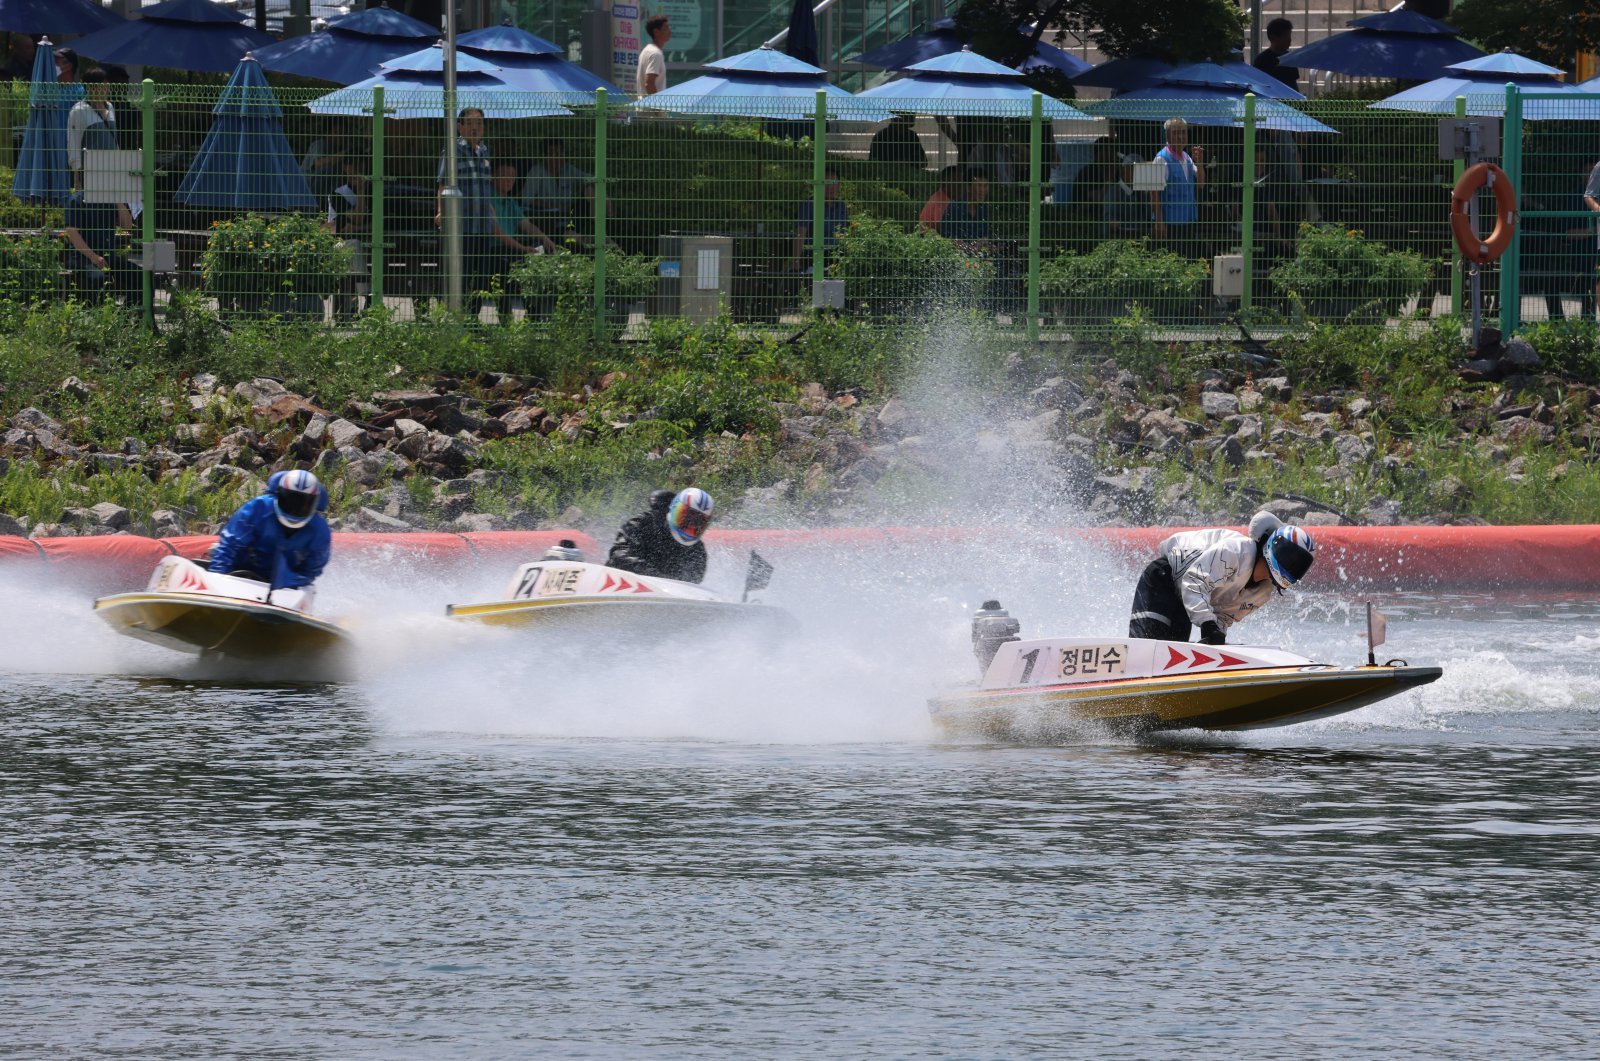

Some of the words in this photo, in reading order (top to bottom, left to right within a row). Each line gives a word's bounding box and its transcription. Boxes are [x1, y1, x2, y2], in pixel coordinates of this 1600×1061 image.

[613, 36, 639, 50] 아카데미
[516, 568, 540, 597] 2
[1020, 648, 1041, 683] 1
[1061, 647, 1121, 676] 정민수
